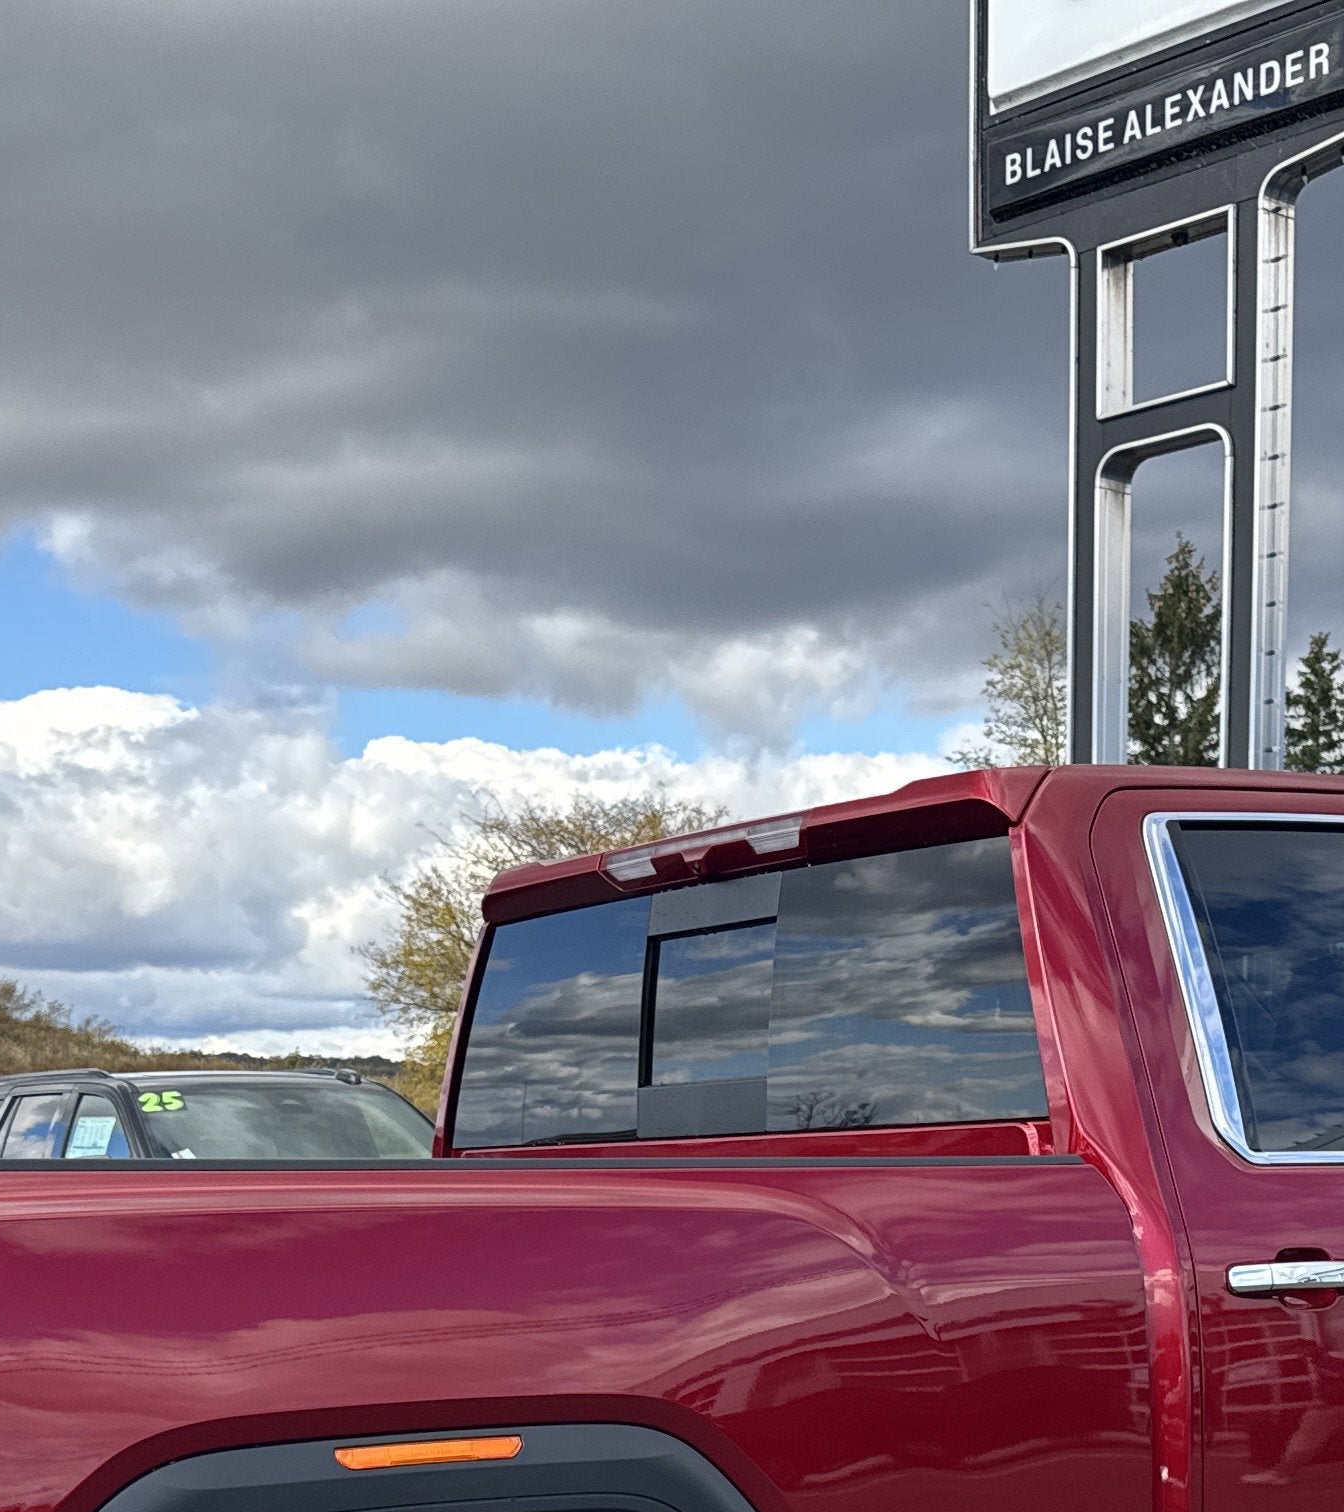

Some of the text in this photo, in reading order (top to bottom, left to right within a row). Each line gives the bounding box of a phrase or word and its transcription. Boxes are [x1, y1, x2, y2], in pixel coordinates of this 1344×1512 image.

[1004, 42, 1331, 186] BLAISE ALEXANDER
[137, 1090, 185, 1113] 25
